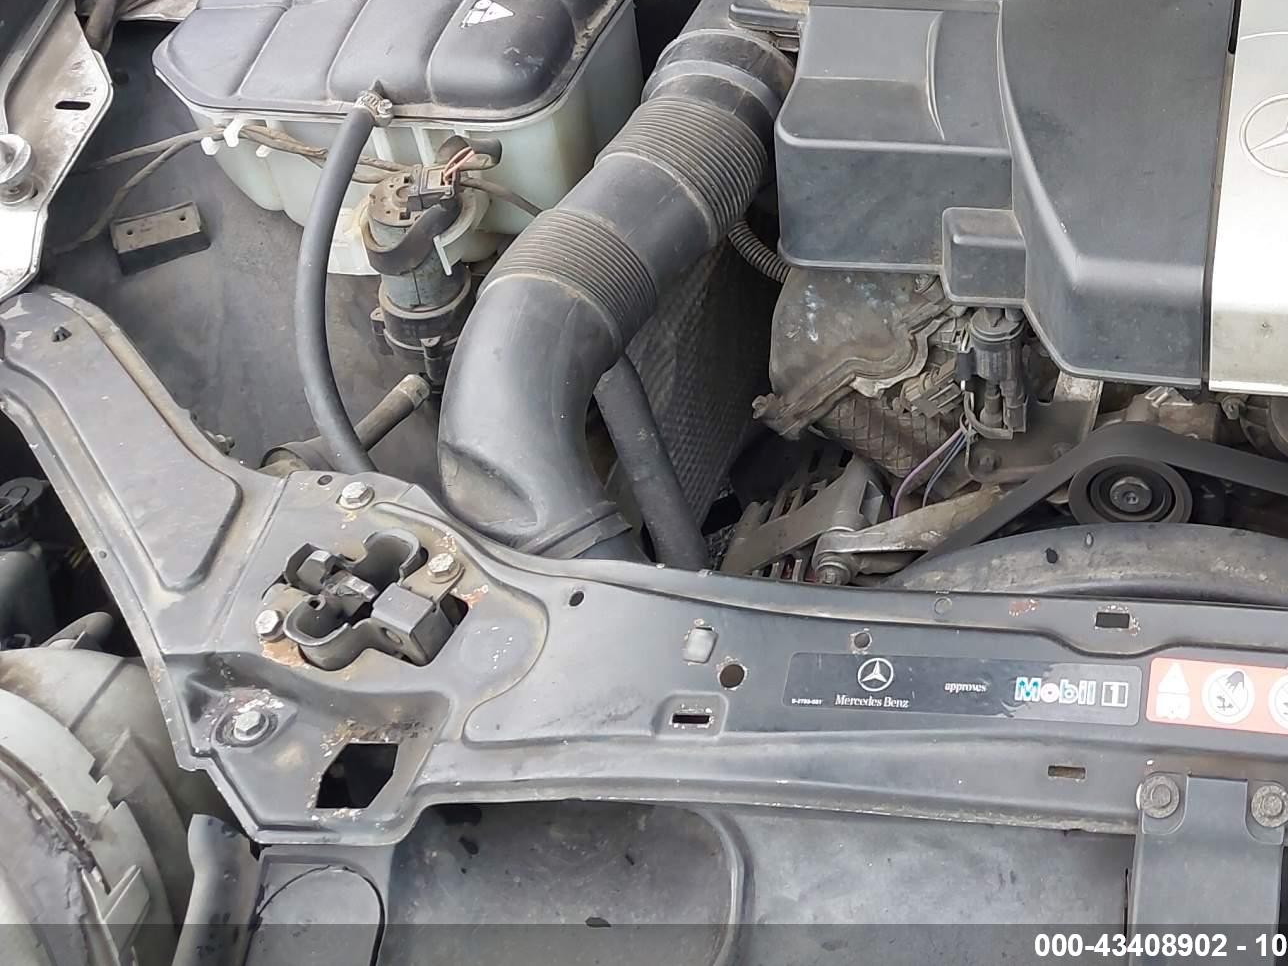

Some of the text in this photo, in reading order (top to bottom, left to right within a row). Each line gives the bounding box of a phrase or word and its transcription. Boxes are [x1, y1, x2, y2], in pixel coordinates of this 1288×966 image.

[944, 682, 987, 693] approves
[1014, 676, 1097, 705] Mobil
[834, 693, 883, 708] Mercedes
[883, 695, 910, 709] Benz
